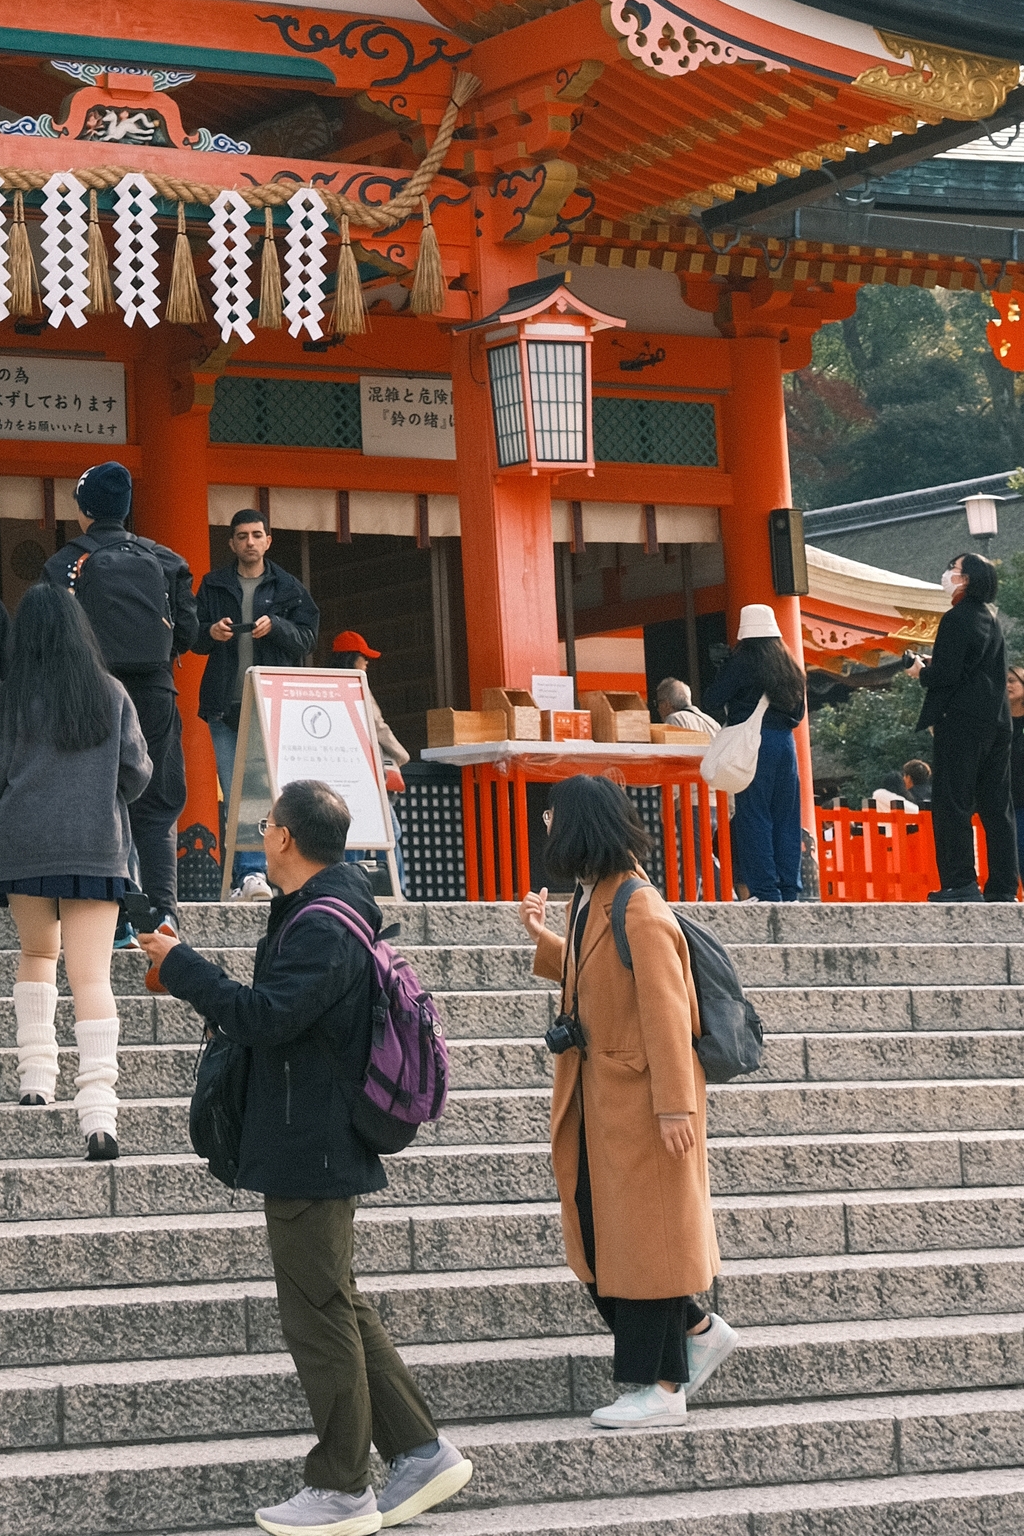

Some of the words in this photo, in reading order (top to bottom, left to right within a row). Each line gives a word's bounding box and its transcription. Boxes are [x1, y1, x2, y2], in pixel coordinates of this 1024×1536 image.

[368, 386, 454, 405] 混雑と危険
